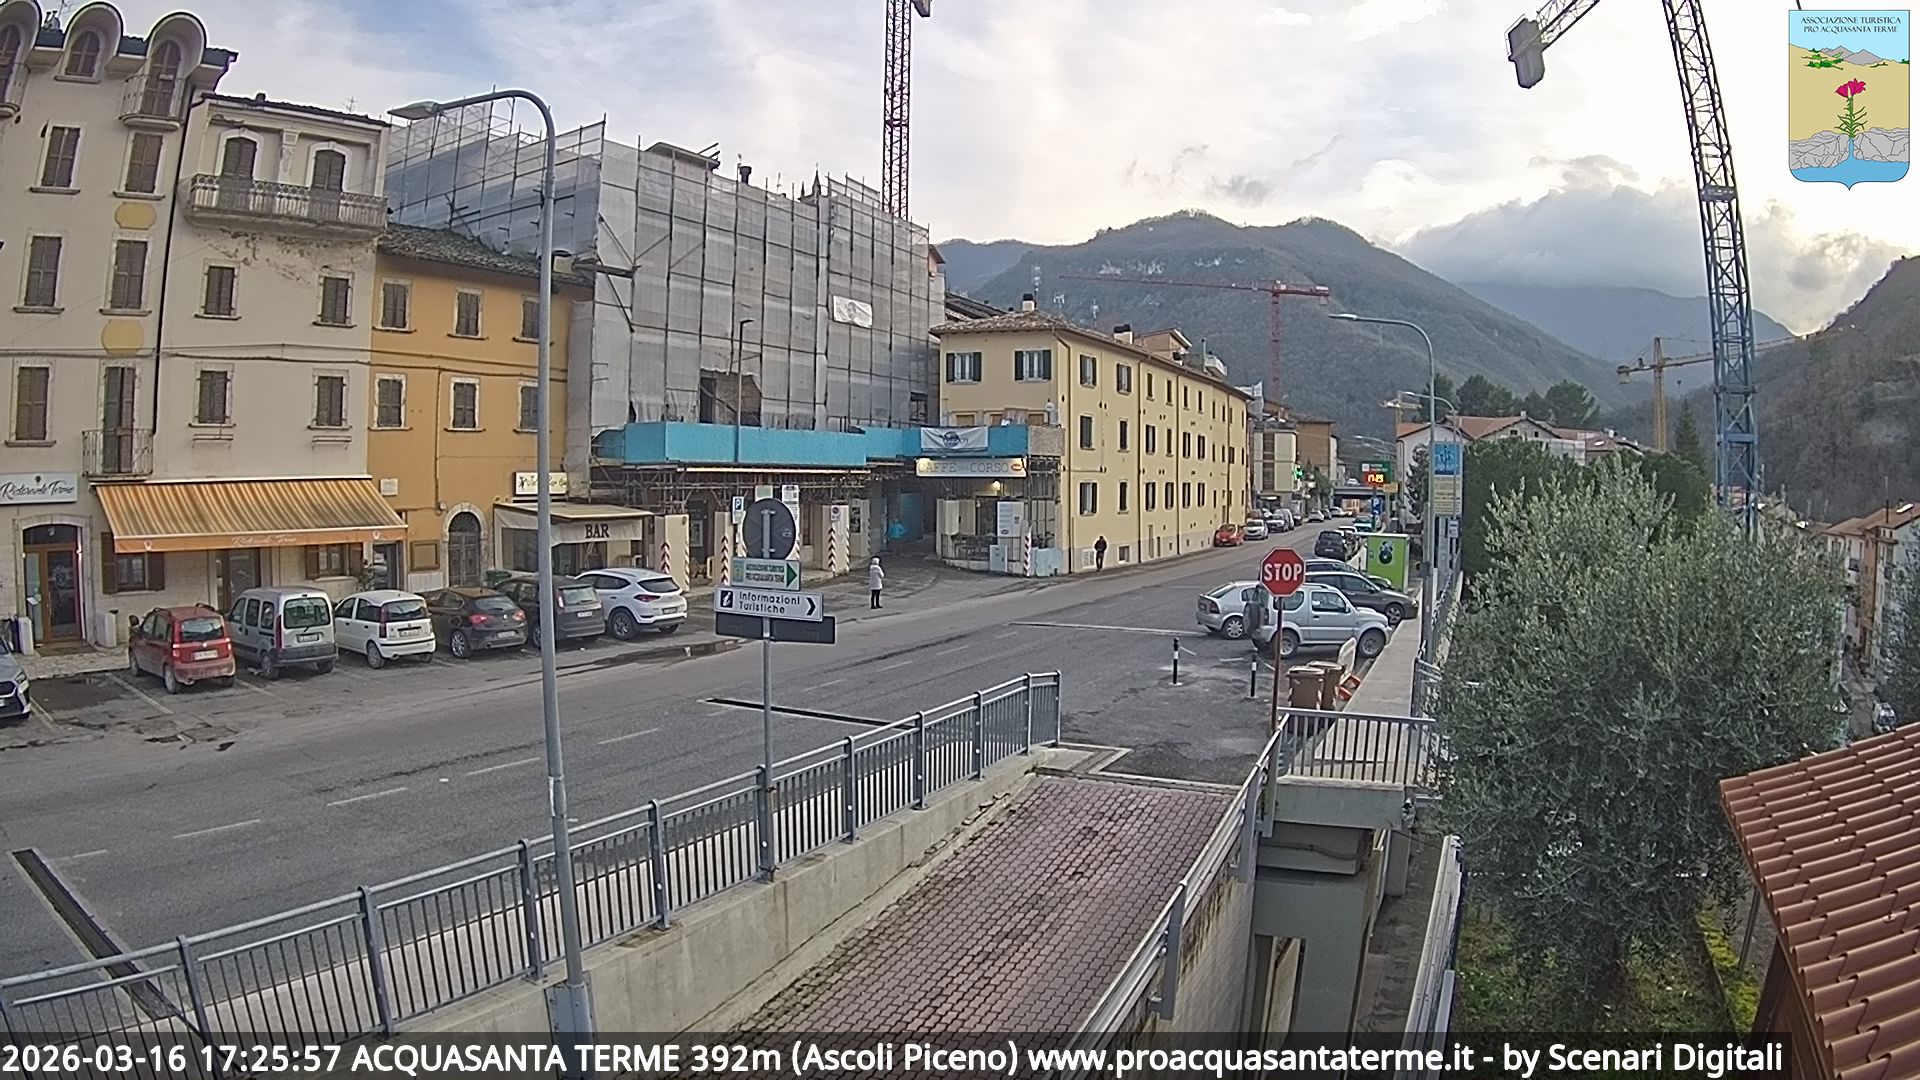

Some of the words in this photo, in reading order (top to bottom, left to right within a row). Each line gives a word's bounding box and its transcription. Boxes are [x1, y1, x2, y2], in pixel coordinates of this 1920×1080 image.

[969, 462, 1009, 473] CORSO
[584, 523, 610, 539] BAR
[1263, 563, 1303, 582] STOP
[739, 591, 800, 605] Informazioni
[739, 601, 786, 614] Turistiche
